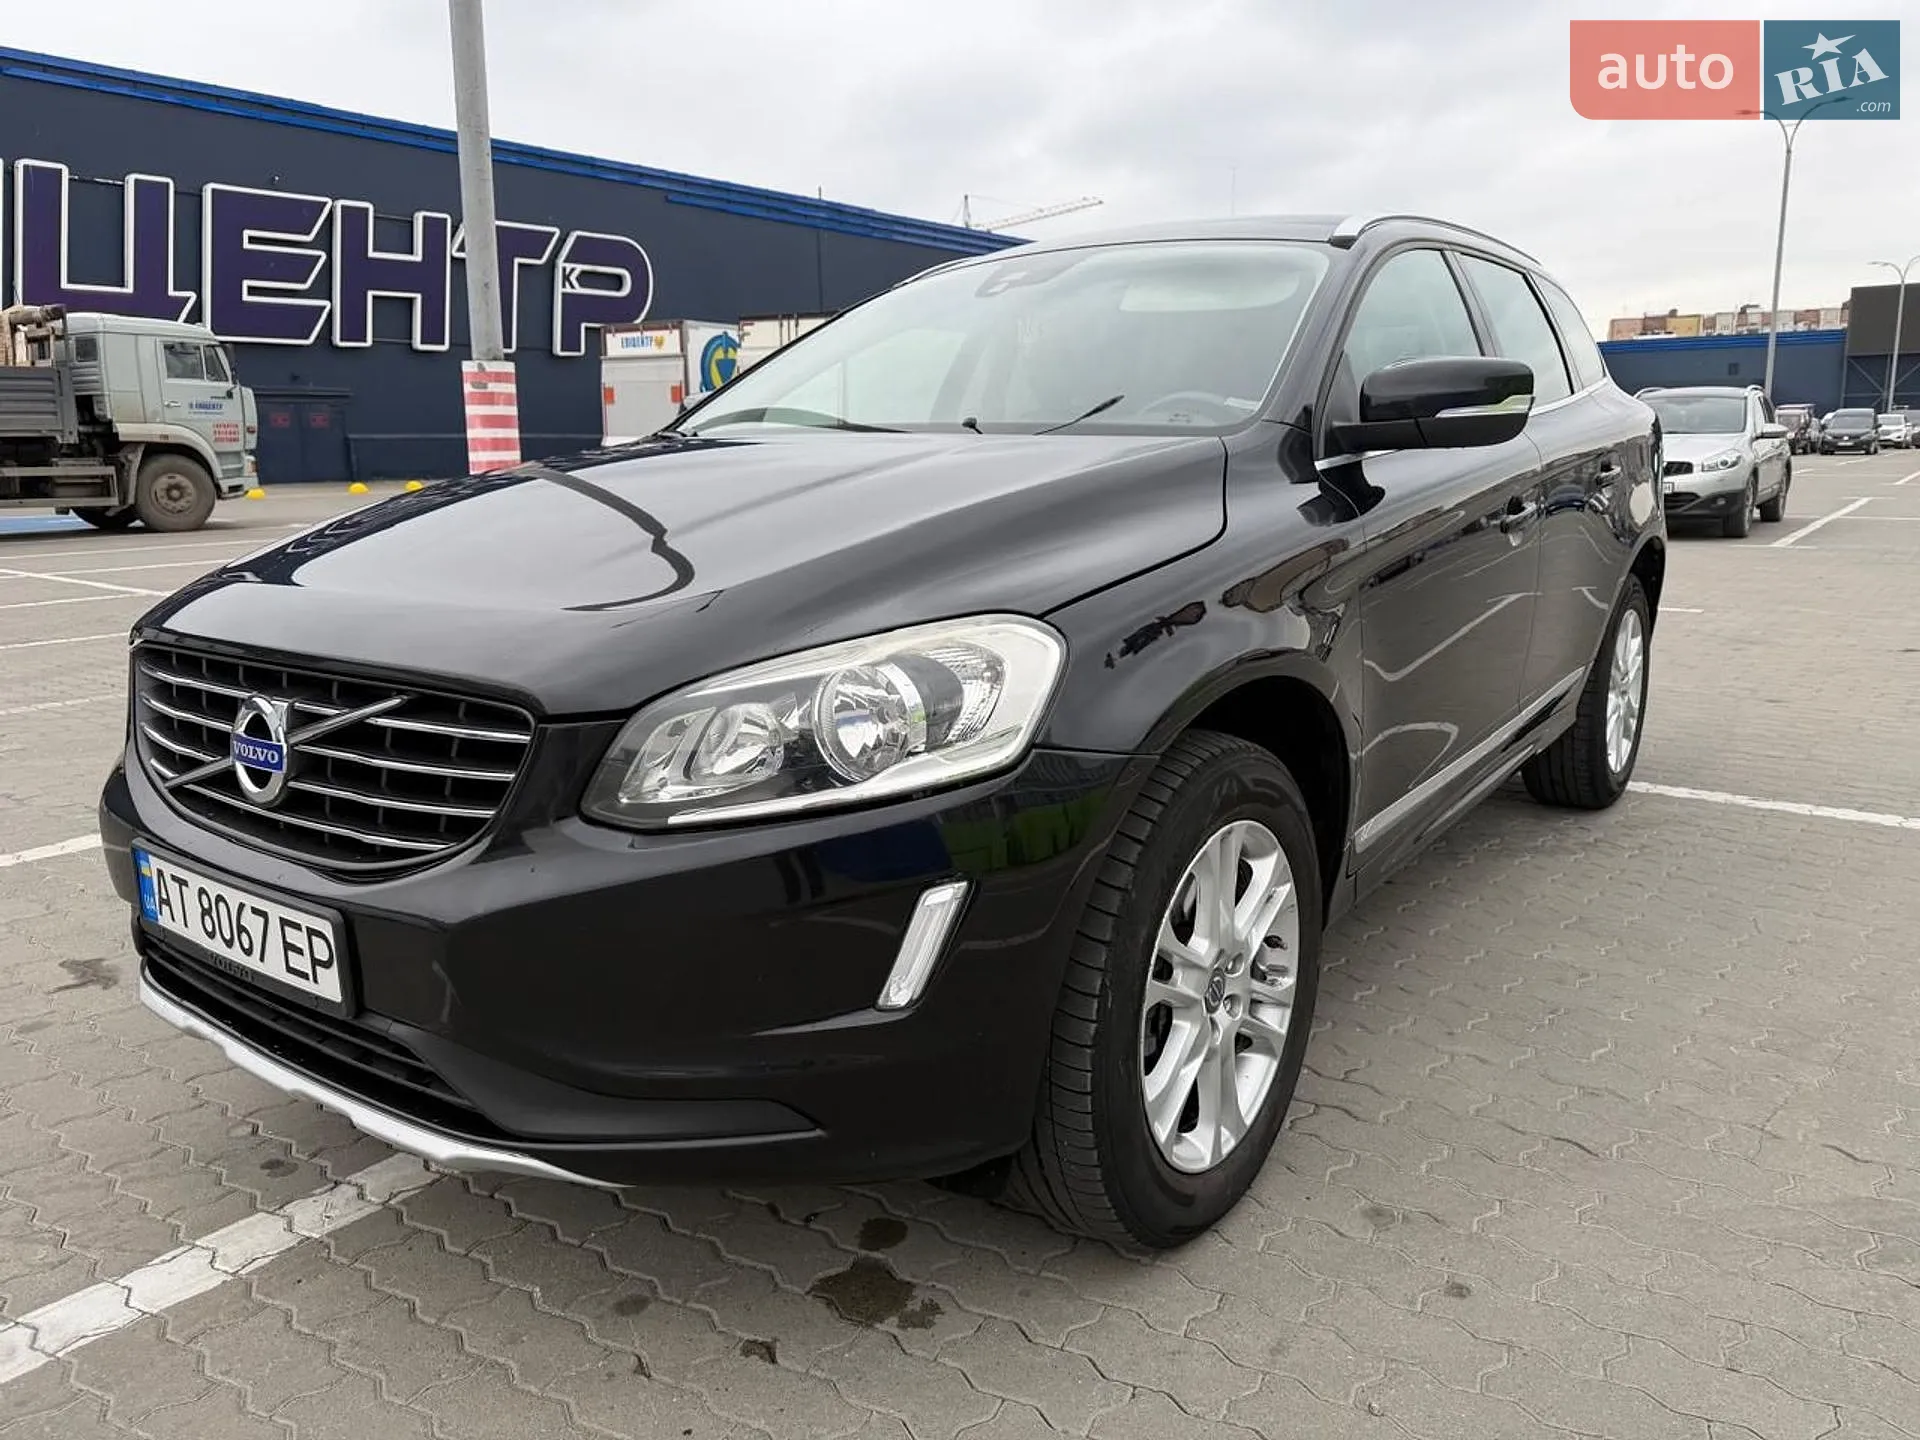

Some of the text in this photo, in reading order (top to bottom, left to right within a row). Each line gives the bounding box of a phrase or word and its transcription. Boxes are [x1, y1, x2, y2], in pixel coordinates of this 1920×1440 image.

[0, 158, 655, 357] ЦЕНТР
[233, 740, 279, 764] VOLVO
[156, 867, 189, 929] AT
[197, 886, 270, 964] 8067
[279, 915, 334, 985] EP
